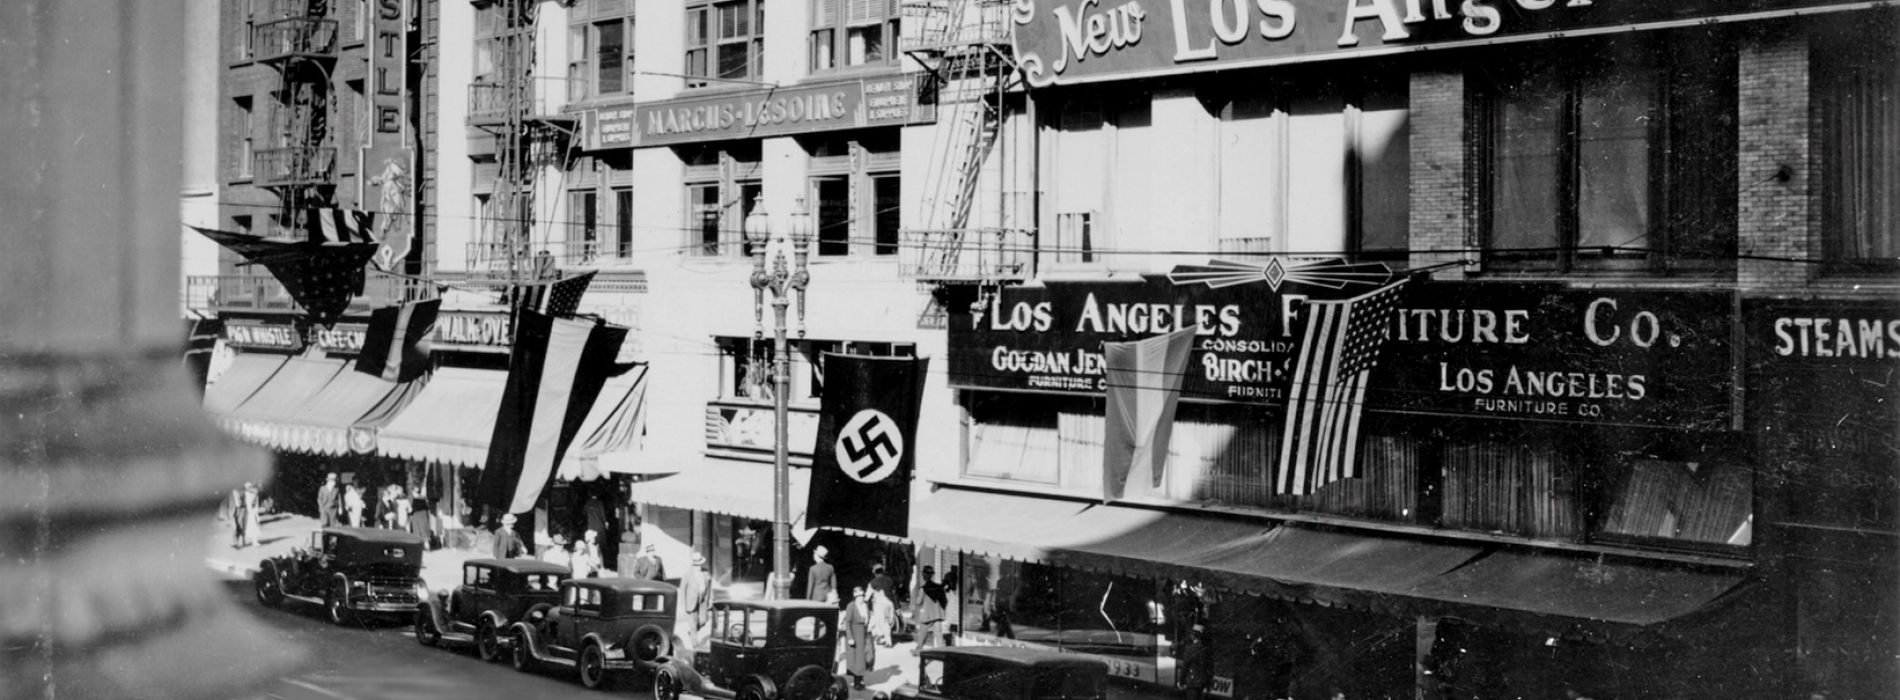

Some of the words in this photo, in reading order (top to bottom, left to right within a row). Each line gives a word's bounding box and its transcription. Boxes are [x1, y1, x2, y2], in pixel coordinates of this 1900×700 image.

[1053, 0, 1145, 75] New
[1171, 0, 1297, 63] Los
[991, 290, 1053, 332] LOS
[1075, 291, 1242, 338] ANGELES
[1281, 293, 1531, 345] FITURE
[1775, 317, 1900, 359] STEAMS
[1439, 362, 1494, 395] LOS
[1503, 364, 1646, 400] ANGELES
[1474, 398, 1568, 414] FURNITURE
